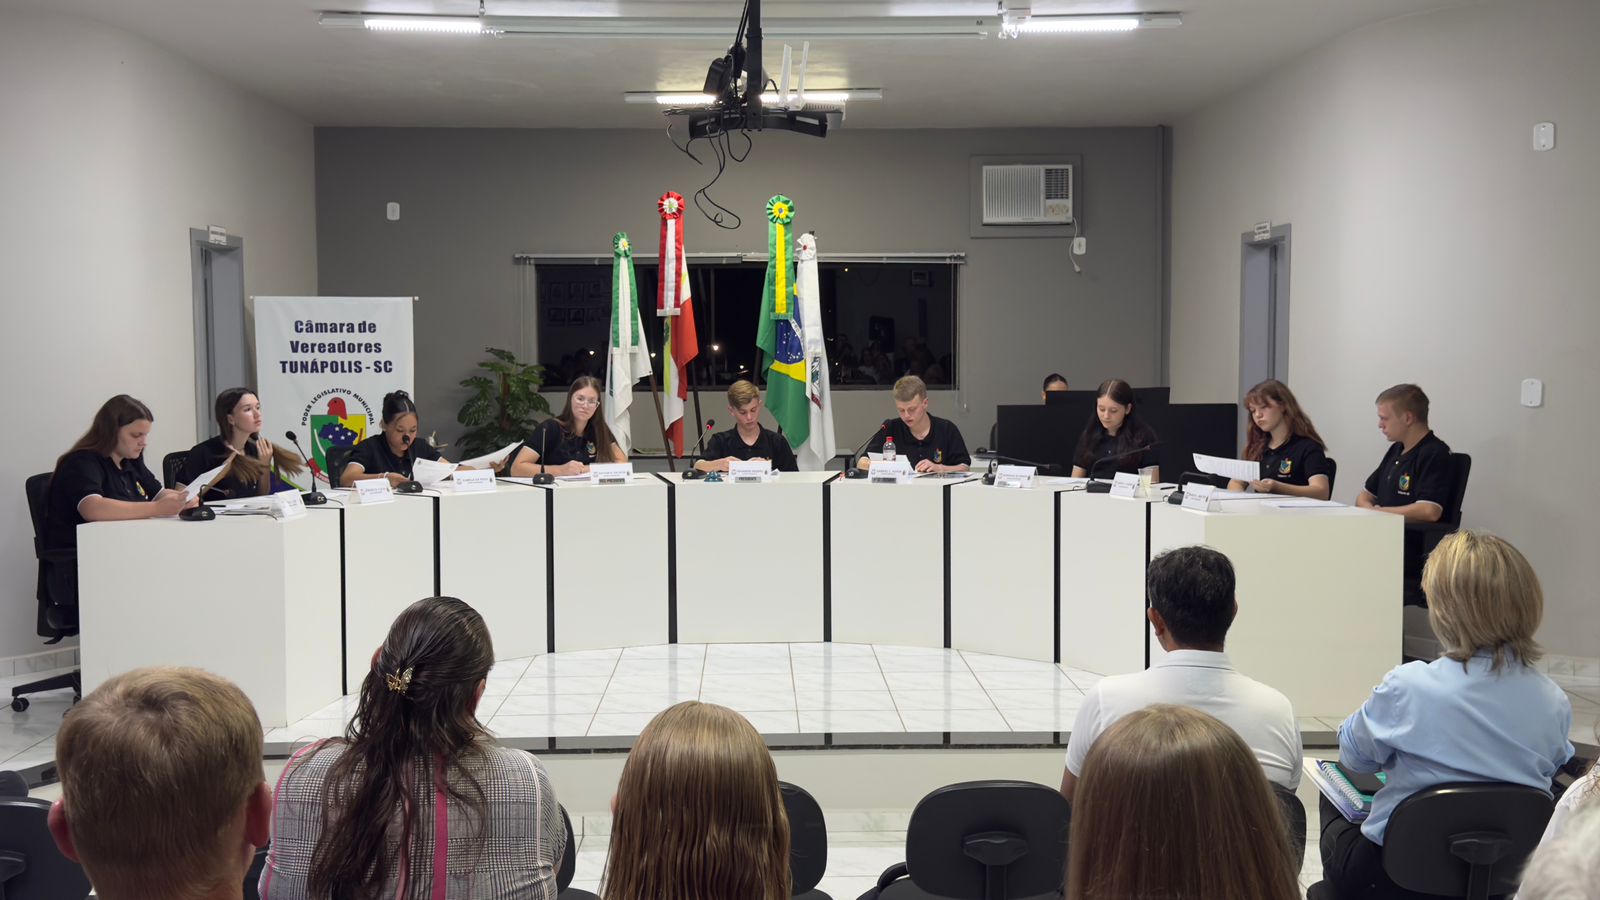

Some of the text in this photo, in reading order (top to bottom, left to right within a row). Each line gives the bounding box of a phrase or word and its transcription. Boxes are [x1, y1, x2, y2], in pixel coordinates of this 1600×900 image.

[294, 320, 377, 333] Câmara de
[289, 340, 382, 353] Vereadores
[279, 358, 363, 373] TUNÁPOLIS
[373, 360, 393, 373] SC
[301, 388, 375, 426] PODER LEGISLATIVO MUNICIPAL
